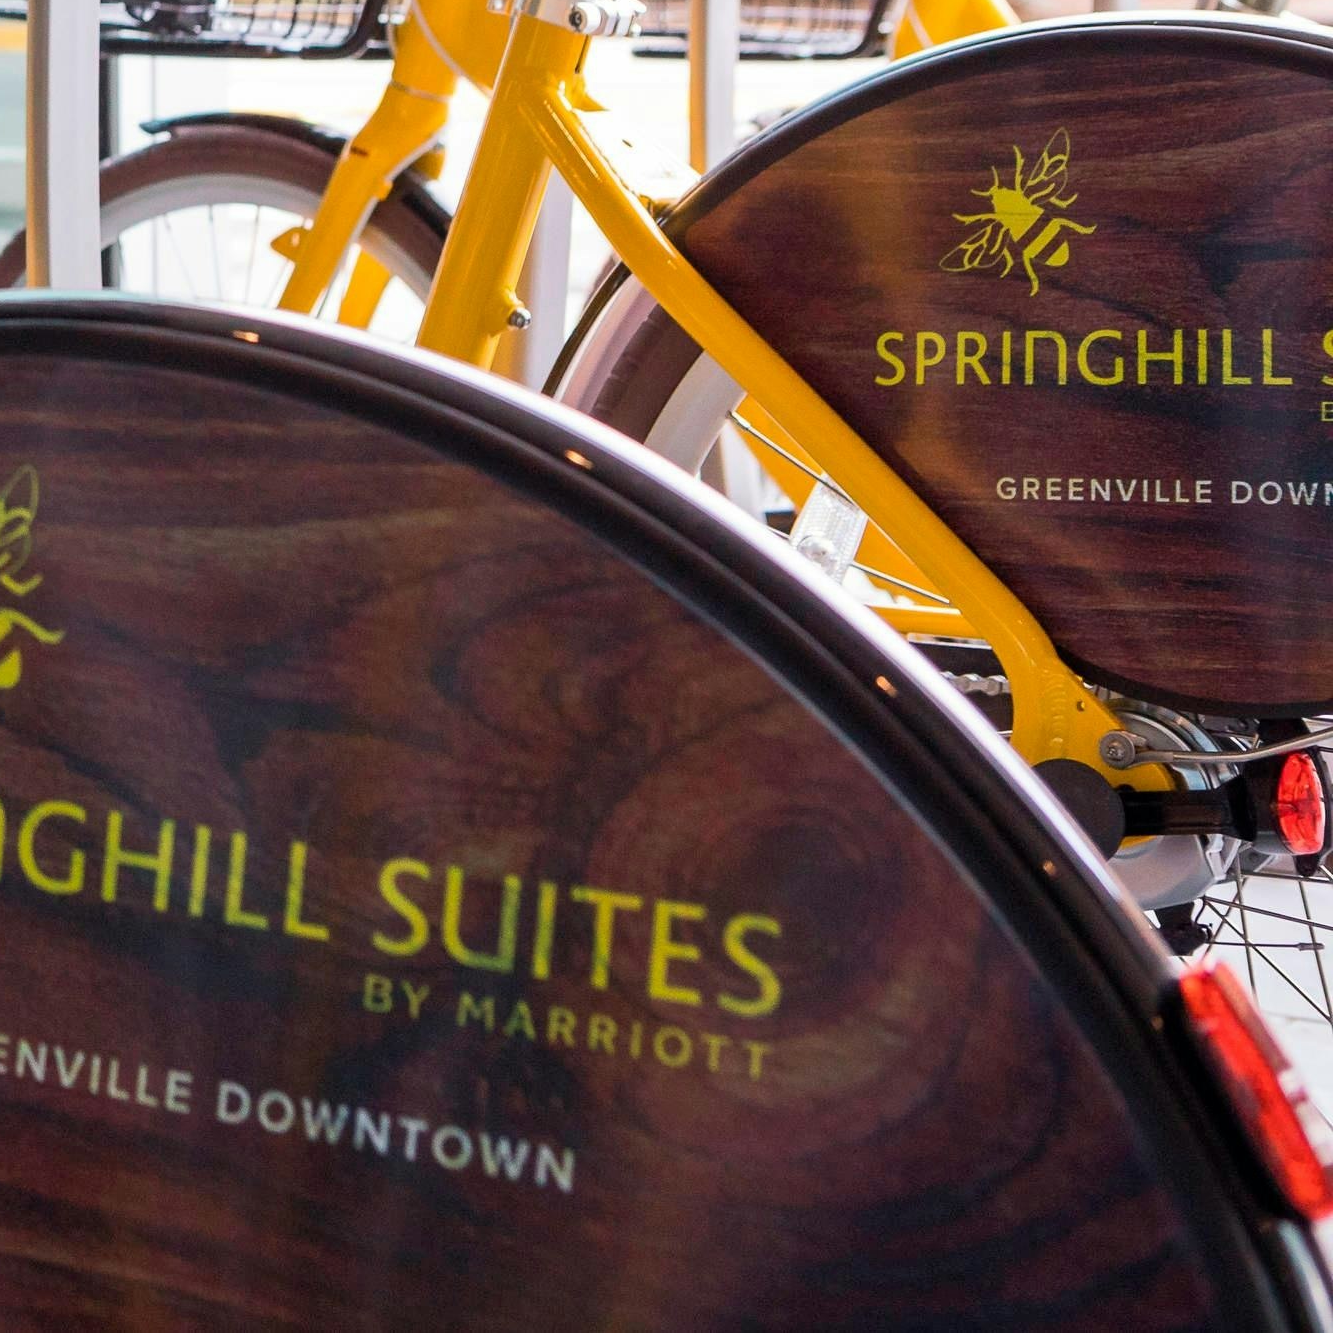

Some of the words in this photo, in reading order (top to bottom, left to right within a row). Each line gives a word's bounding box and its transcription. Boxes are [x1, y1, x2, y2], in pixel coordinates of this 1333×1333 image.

[874, 328, 1294, 387] SPRINGHILL
[996, 476, 1213, 504] GREENVILLE
[371, 856, 782, 1017] SUITES
[364, 973, 428, 1018] BY
[457, 990, 769, 1079] MARRIOTT
[215, 1080, 575, 1192] DOWNTOWN
